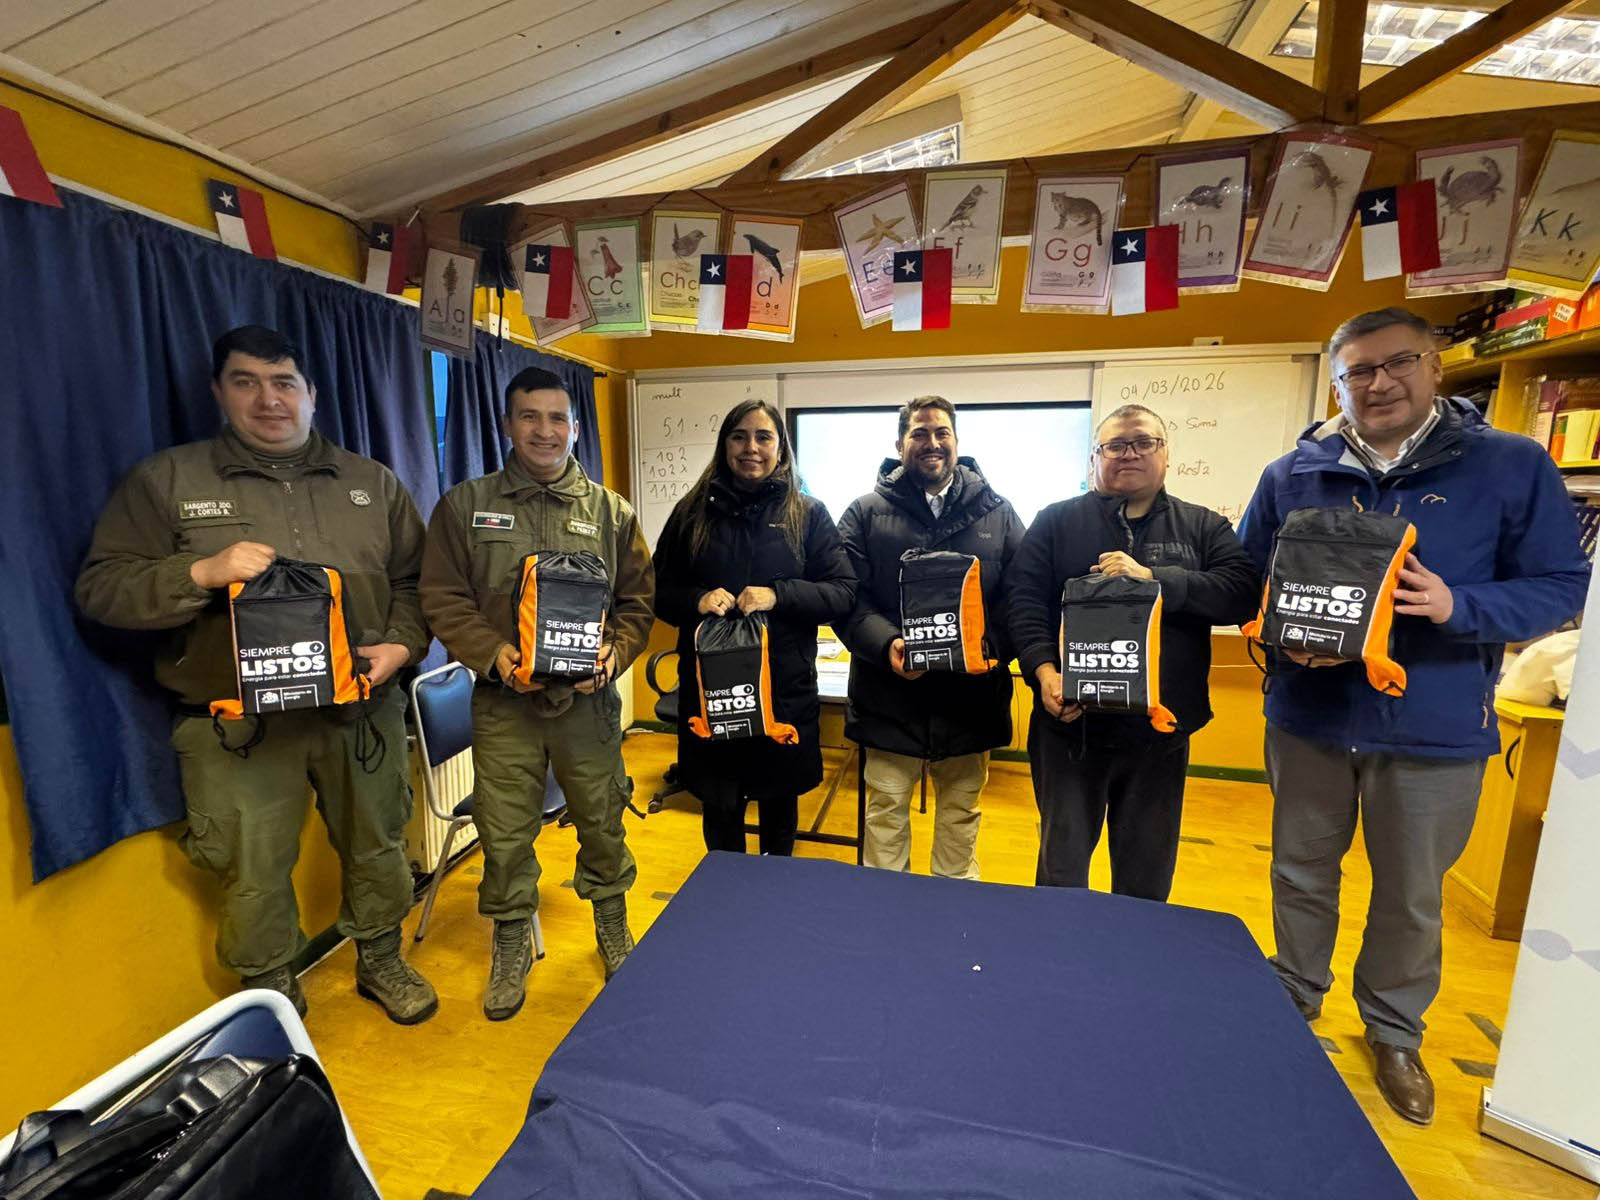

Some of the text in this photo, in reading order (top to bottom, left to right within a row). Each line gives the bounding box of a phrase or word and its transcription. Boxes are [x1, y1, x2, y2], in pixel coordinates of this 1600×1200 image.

[756, 276, 773, 298] d
[1120, 371, 1225, 400] 04/03/2026
[1281, 581, 1331, 596] SIEMPRE
[1277, 593, 1364, 619] LISTOS
[546, 619, 584, 631] SIEMPRE
[904, 616, 933, 626] IEMPRE
[240, 646, 291, 658] SIEMPRE
[1068, 642, 1110, 651] SIEMPRE
[241, 655, 327, 676] LISTOS
[1068, 653, 1139, 668] LISTOS
[705, 688, 732, 698] EMPRE
[707, 695, 757, 712] ISTOS
